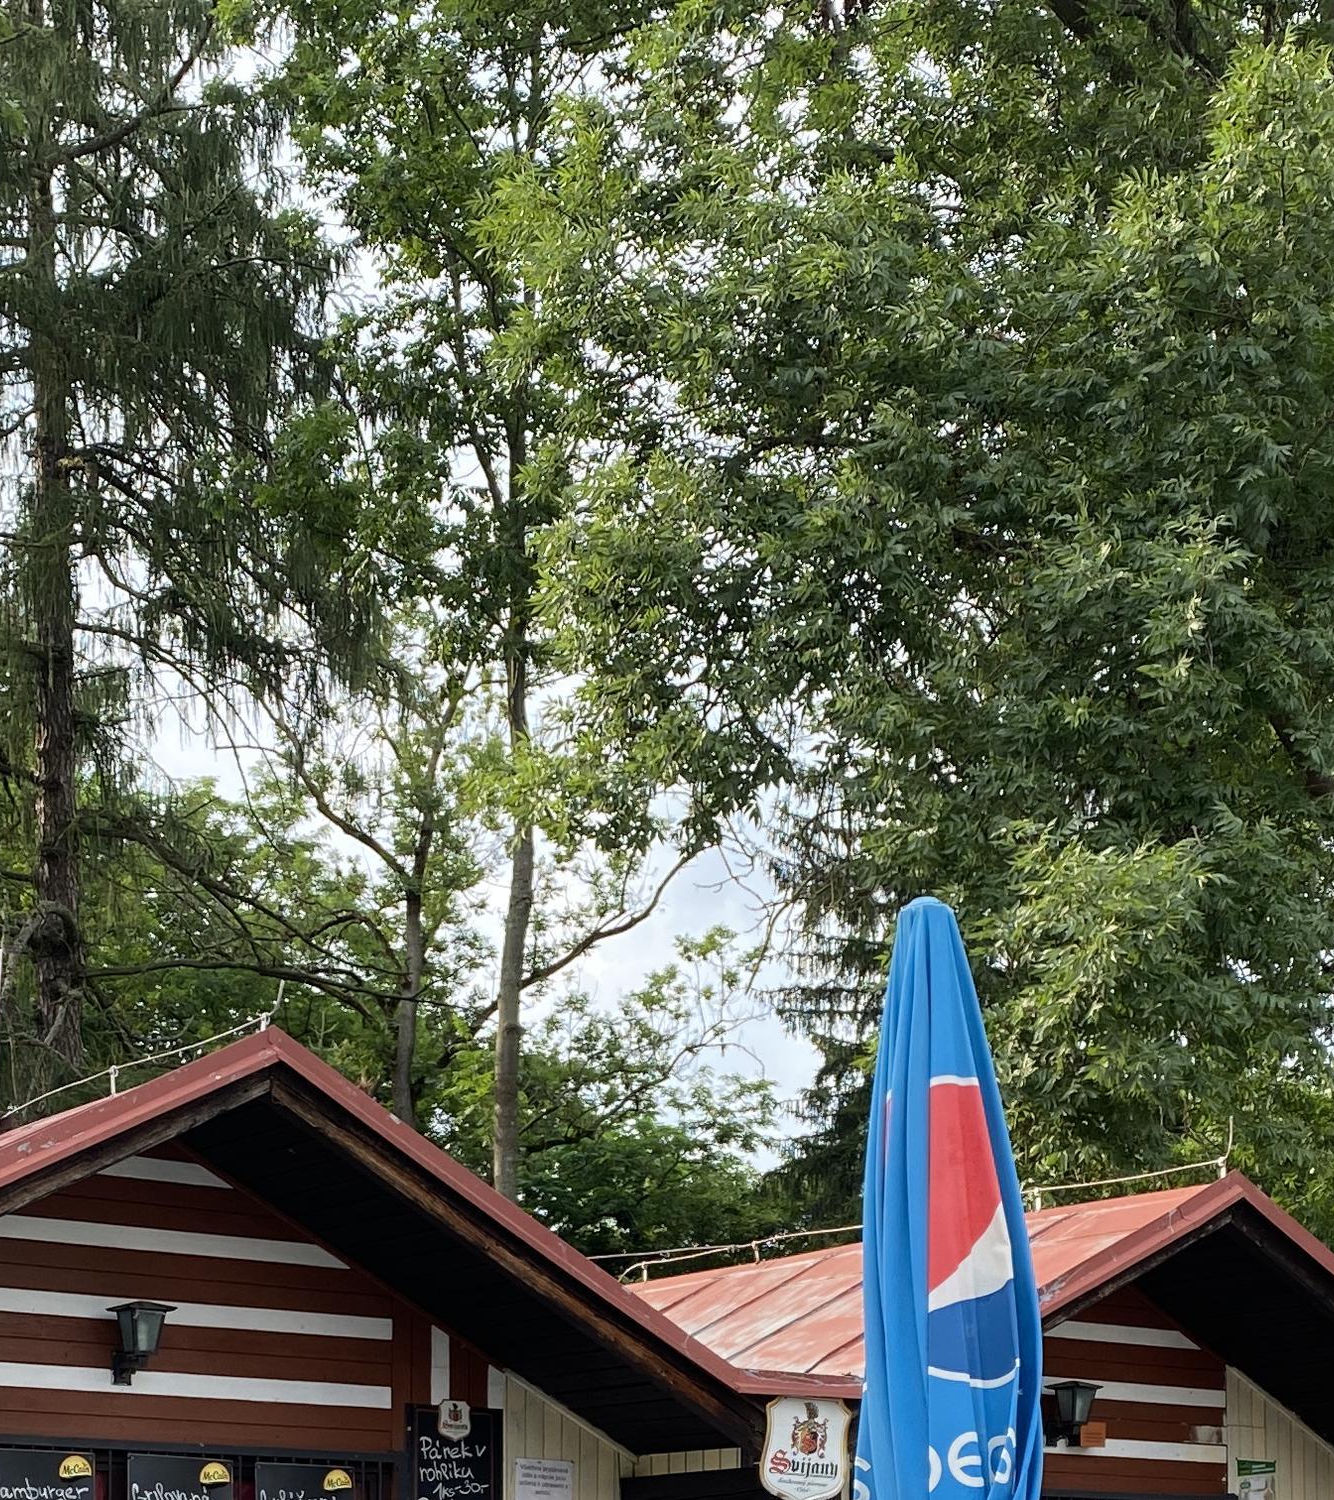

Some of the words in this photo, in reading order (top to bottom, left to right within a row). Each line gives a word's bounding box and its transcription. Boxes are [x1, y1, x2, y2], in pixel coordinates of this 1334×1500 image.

[419, 1436, 473, 1460] Párek
[475, 1445, 486, 1457] v
[62, 1463, 90, 1475] McCain
[769, 1449, 838, 1479] Svijany
[203, 1470, 230, 1481] McCain
[327, 1476, 352, 1488] McCain
